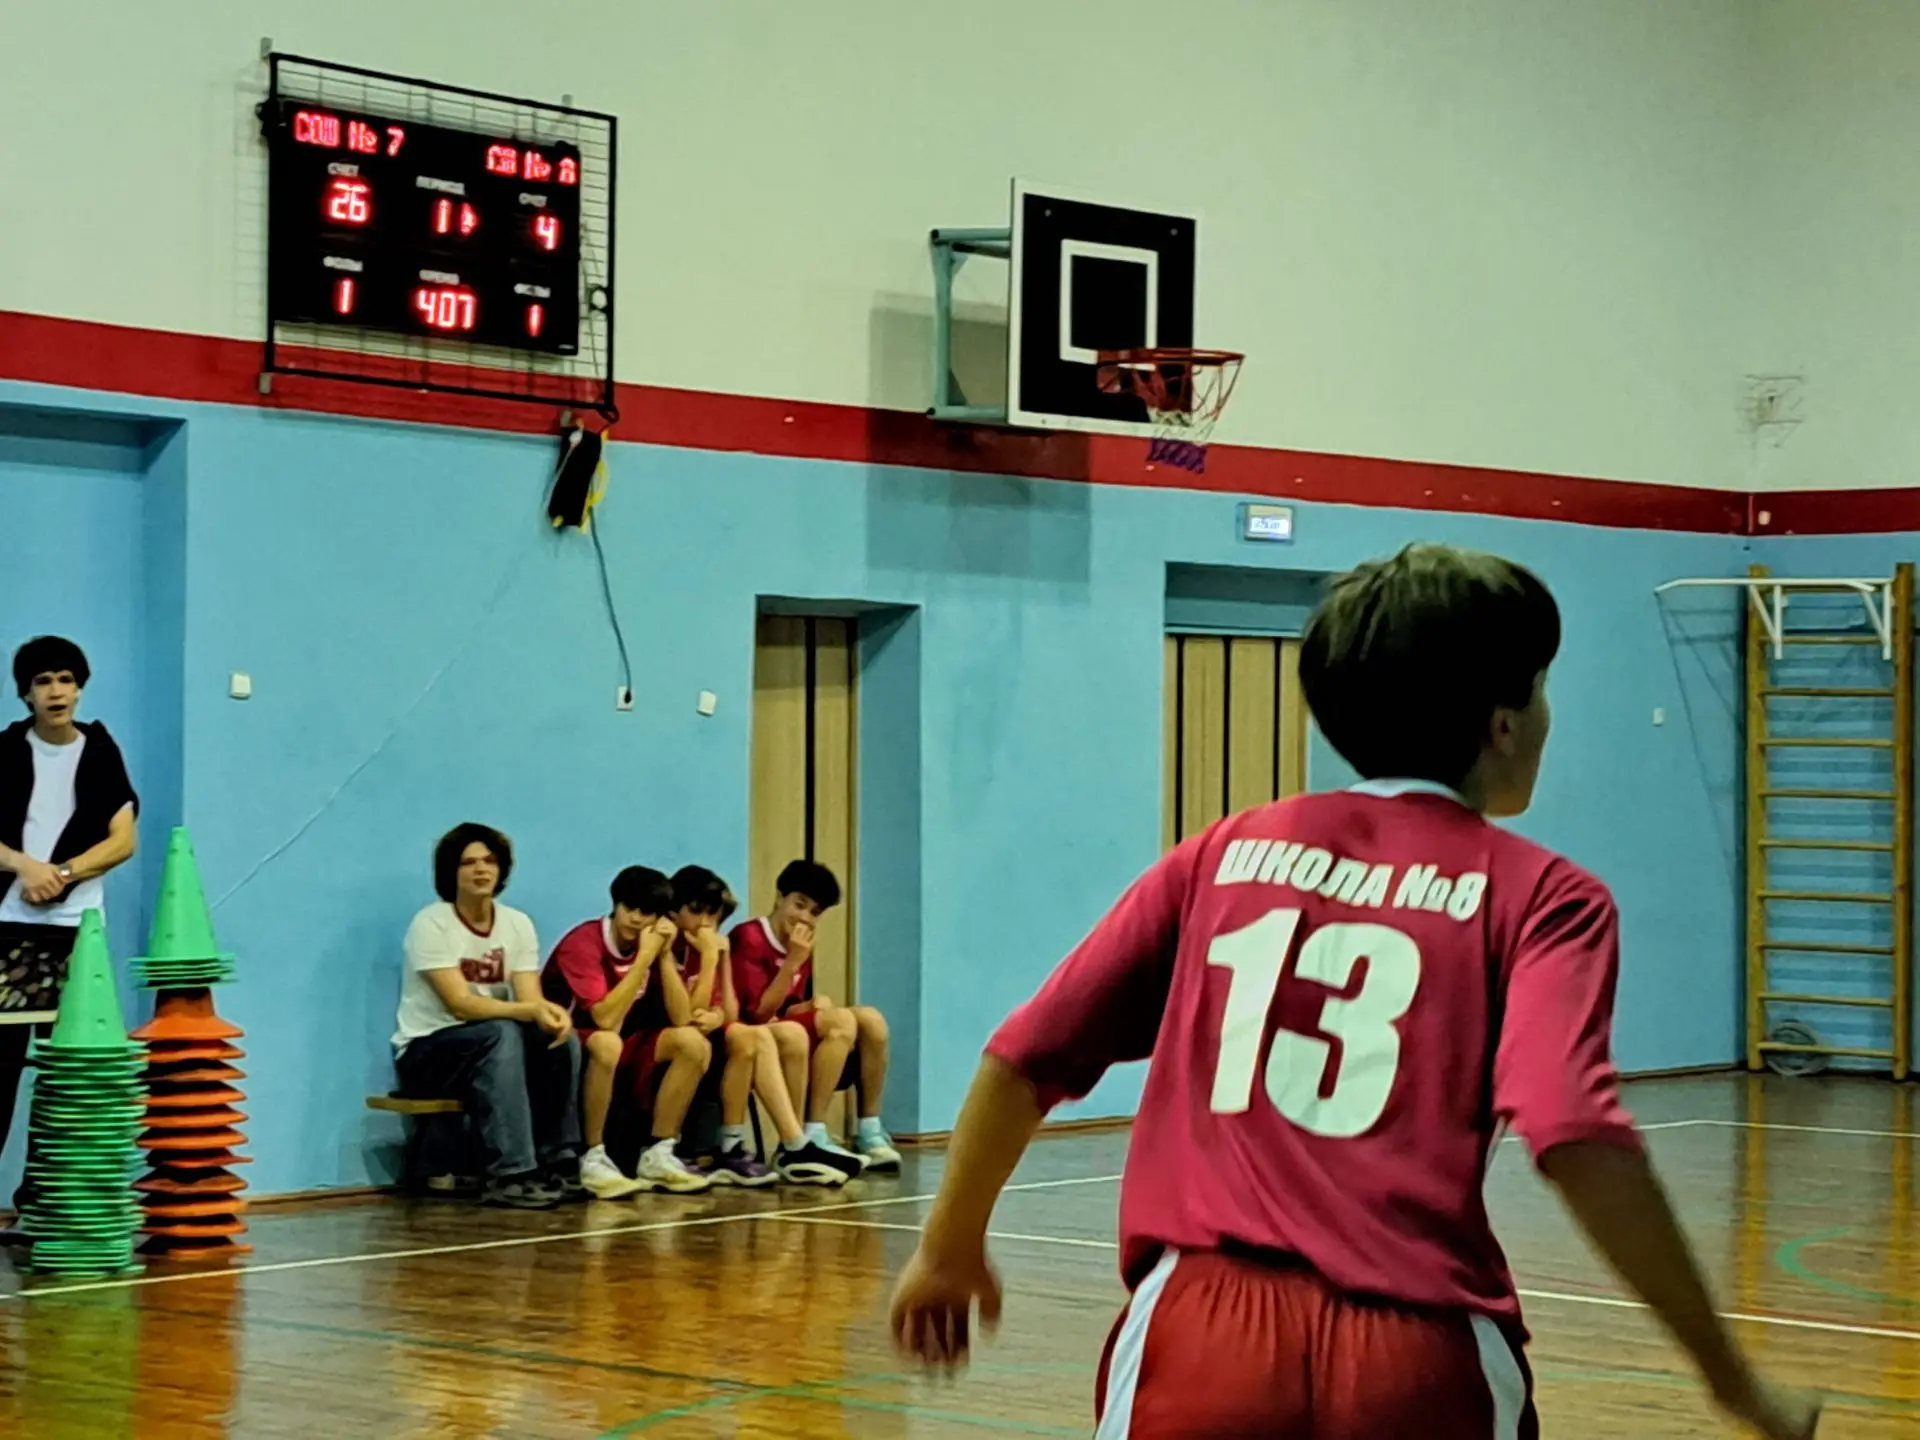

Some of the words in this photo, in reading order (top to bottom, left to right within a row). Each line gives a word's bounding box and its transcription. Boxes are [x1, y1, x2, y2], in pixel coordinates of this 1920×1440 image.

[386, 127, 404, 156] 7
[330, 182, 368, 222] 26
[437, 199, 449, 233] 1
[536, 215, 556, 250] 4
[339, 278, 352, 314] 1
[528, 304, 542, 337] 1
[1214, 839, 1395, 908] ШКОЛА
[1207, 908, 1422, 1138] 13
